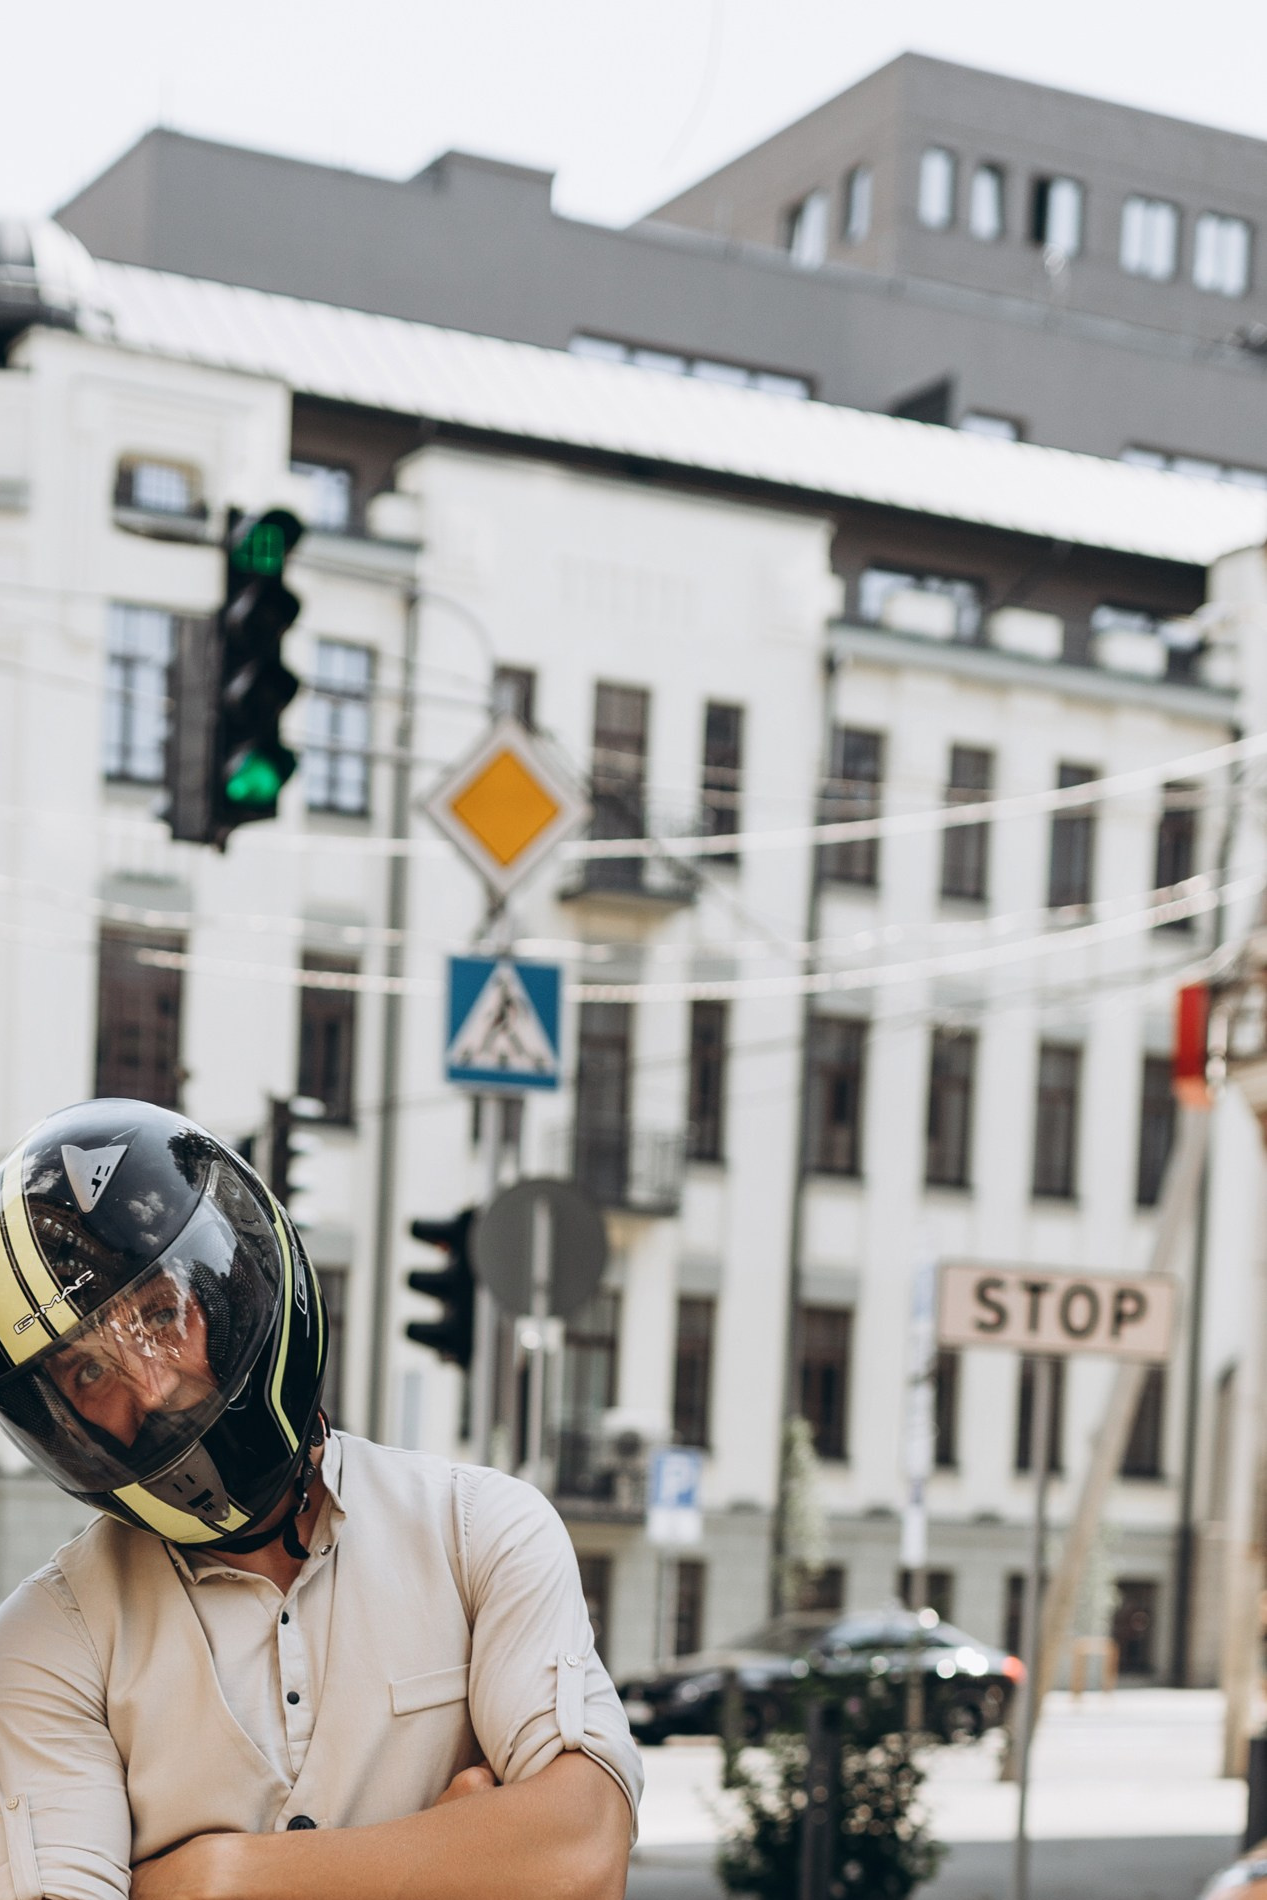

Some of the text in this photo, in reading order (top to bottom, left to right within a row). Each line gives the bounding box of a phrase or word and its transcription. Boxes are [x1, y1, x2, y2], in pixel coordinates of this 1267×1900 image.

[13, 1269, 94, 1336] G-MAC
[974, 1275, 1149, 1341] STOP
[660, 1450, 694, 1502] P
